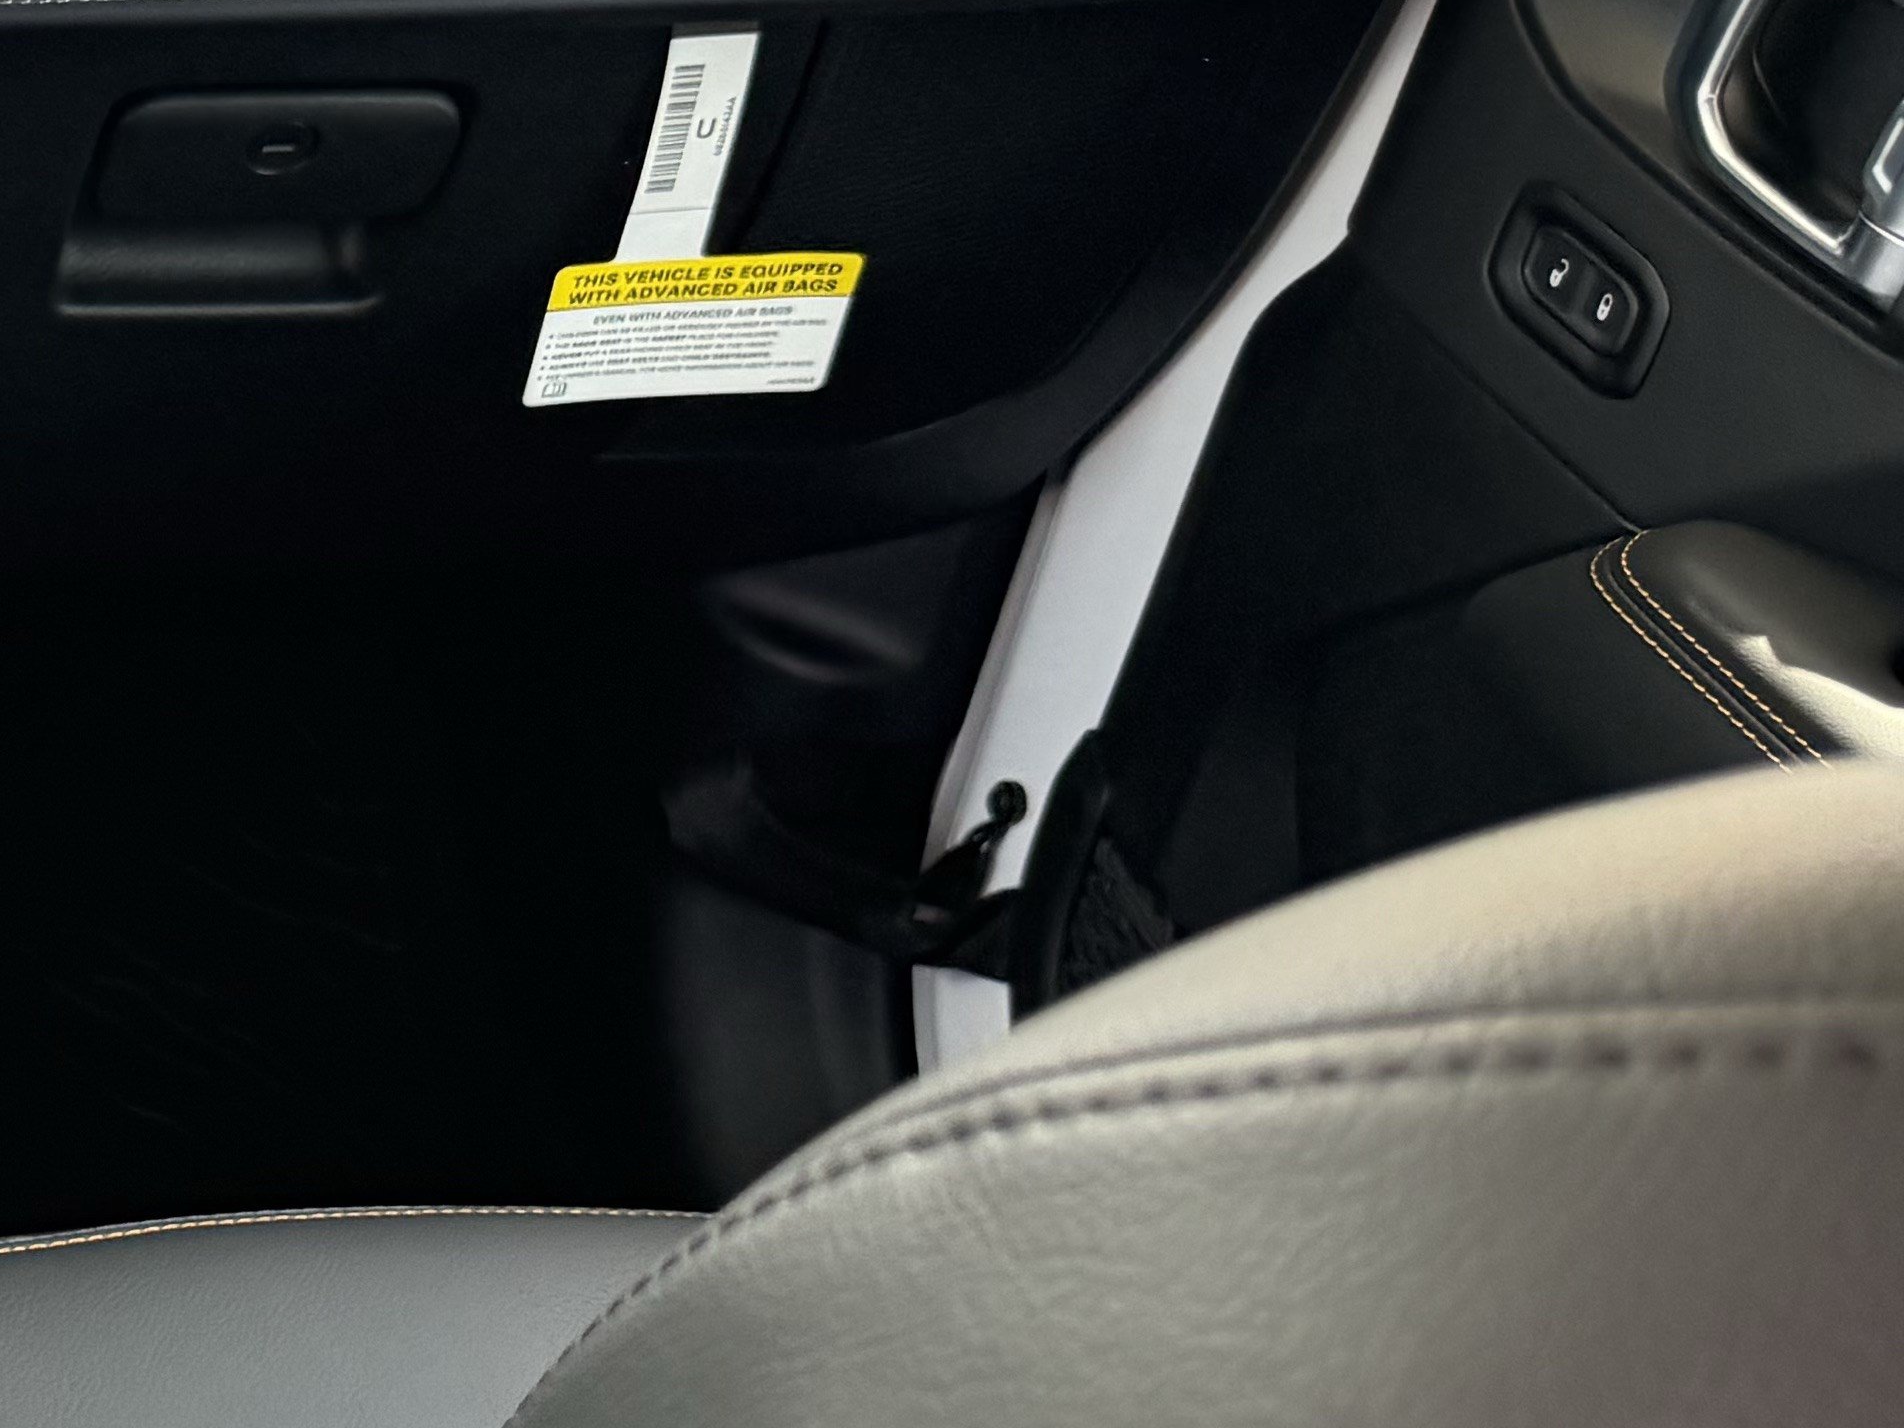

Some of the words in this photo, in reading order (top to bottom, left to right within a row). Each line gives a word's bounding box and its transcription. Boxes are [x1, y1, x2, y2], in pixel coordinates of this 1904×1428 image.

[574, 272, 618, 289] THIS
[624, 267, 710, 283] VEHICLE
[714, 266, 735, 279] IS
[740, 263, 843, 278] EQUIPPED
[569, 289, 620, 304] WITH
[623, 283, 737, 300] ADVANCED
[743, 281, 777, 296] AIR
[782, 279, 838, 293] BAGS
